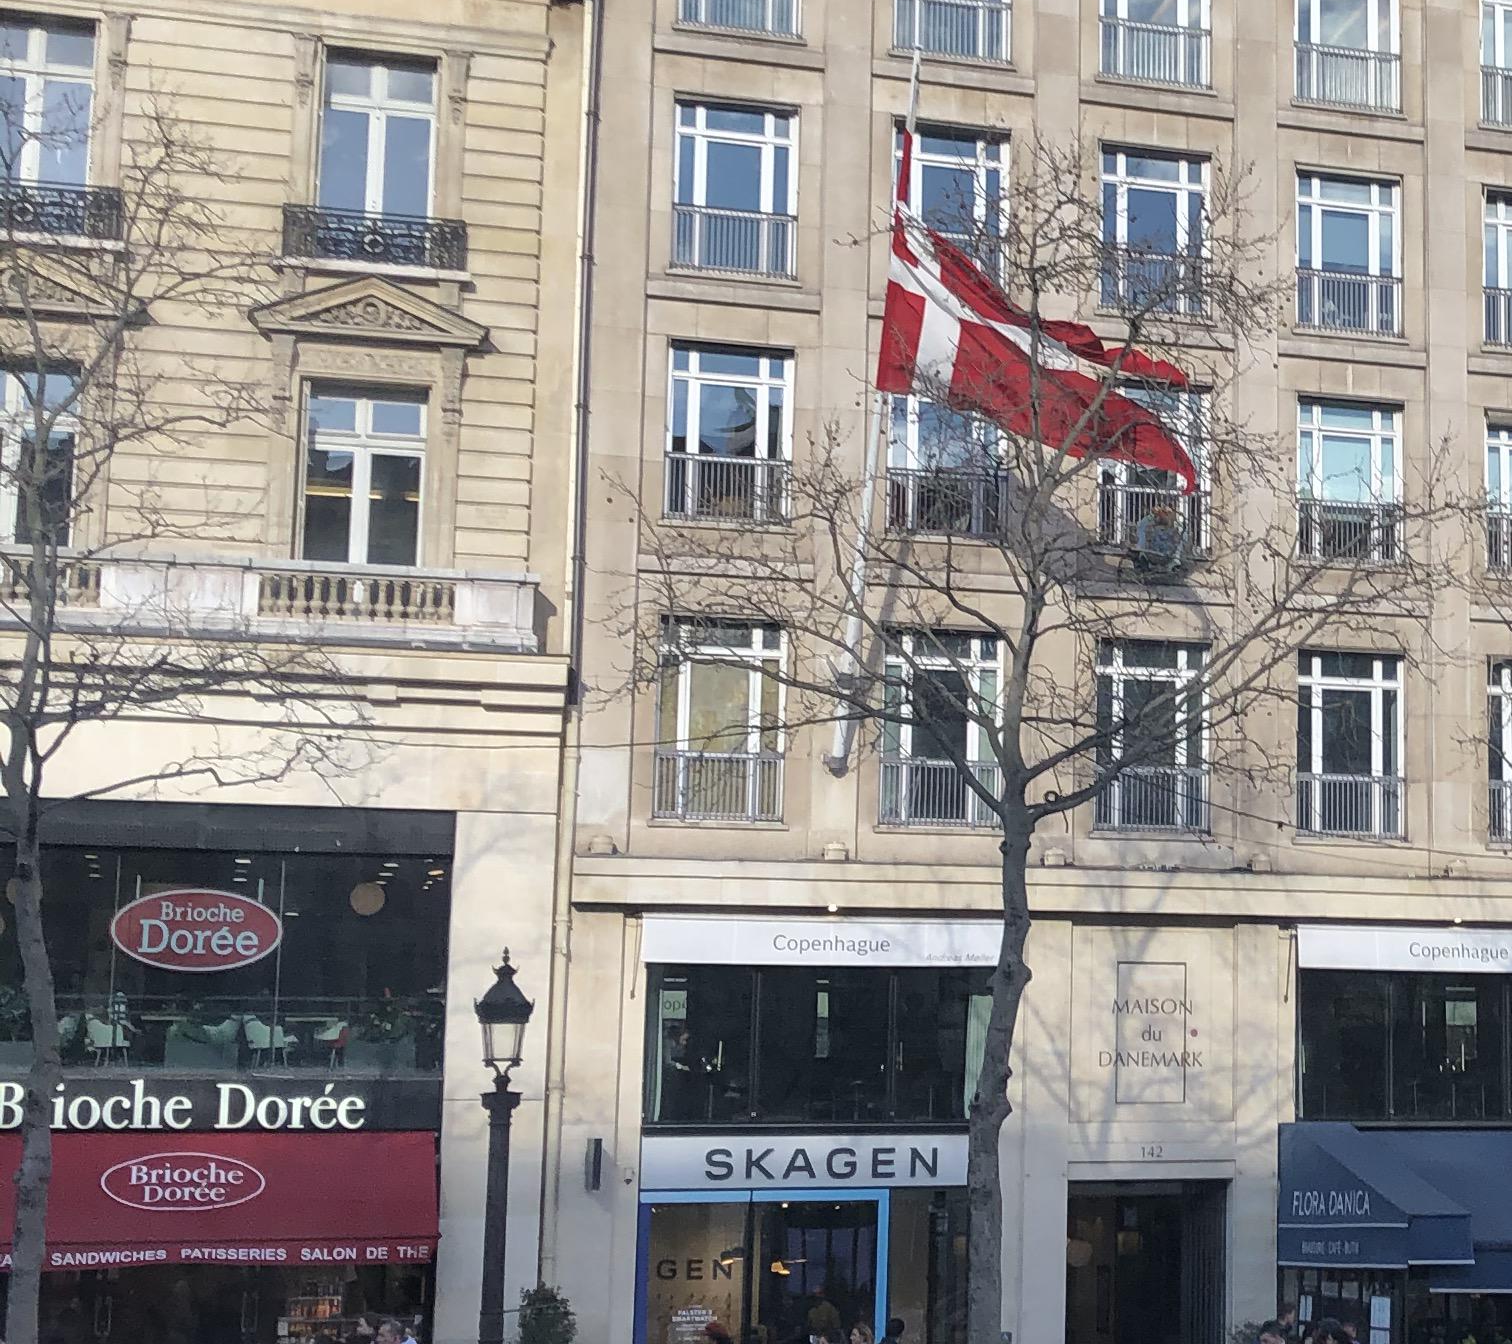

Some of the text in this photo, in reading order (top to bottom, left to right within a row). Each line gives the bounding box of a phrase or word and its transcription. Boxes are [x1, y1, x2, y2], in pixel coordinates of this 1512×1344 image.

[160, 901, 244, 923] Brioche
[137, 919, 260, 956] Dorée
[773, 934, 891, 956] Copenhague
[1409, 942, 1509, 962] Copenhague
[1112, 998, 1194, 1015] MAISON
[1141, 1024, 1162, 1042] du
[1098, 1051, 1203, 1068] DANEMARK
[0, 1079, 366, 1130] Bioche Dorée
[1141, 1145, 1163, 1158] 142
[129, 1163, 244, 1186] Brioche
[704, 1147, 939, 1181] SKAGEN
[143, 1182, 226, 1203] Dorée
[1292, 1190, 1371, 1216] FLORA DANICA
[51, 1249, 167, 1266] SANDWICHES
[181, 1248, 288, 1261] PATISSERIES
[300, 1247, 357, 1261] SALON
[366, 1247, 388, 1259] DE
[657, 1259, 732, 1281] GEN
